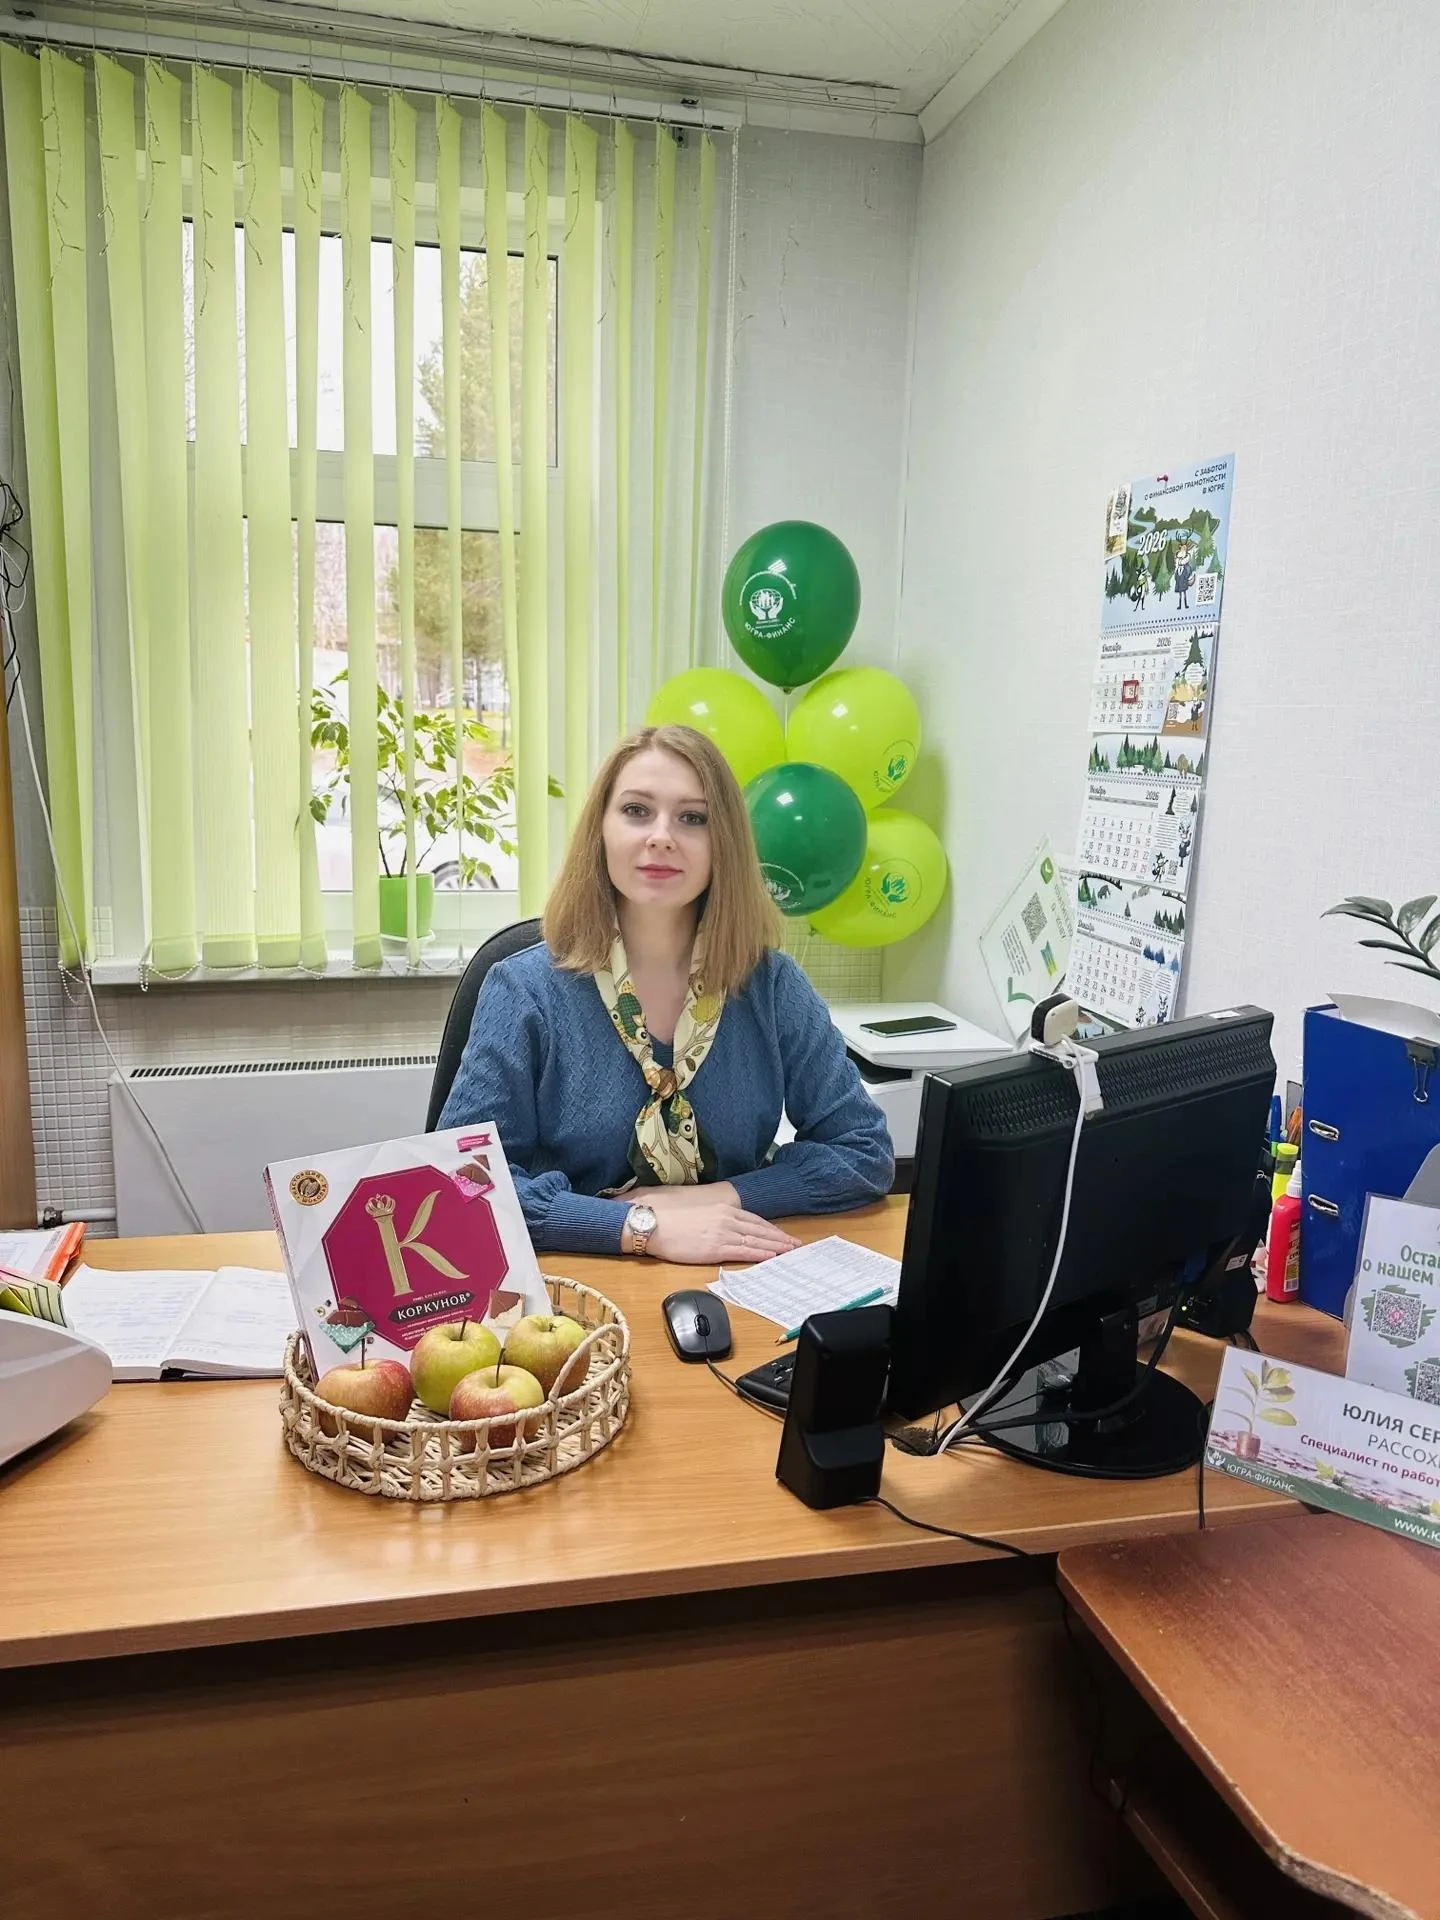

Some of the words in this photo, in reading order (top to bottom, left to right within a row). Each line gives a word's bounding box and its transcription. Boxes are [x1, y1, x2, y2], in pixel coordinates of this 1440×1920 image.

[1200, 462, 1228, 475] ЗАБОТОЙ
[1149, 484, 1184, 499] ФИНАНСОВОЙ
[1184, 473, 1227, 488] ГРАМОТНОСТИ
[1208, 483, 1226, 493] ЮГРЕ
[1137, 529, 1168, 556] 2026
[744, 617, 796, 639] ЮГРА-ФИНАНС
[1400, 1244, 1440, 1269] Оста
[1362, 1258, 1372, 1272] о
[1377, 1261, 1434, 1286] нашем
[397, 1293, 467, 1320] КОРКУНОВ
[1342, 1402, 1404, 1434] ЮЛИЯ
[1300, 1434, 1378, 1468] Специалист
[1382, 1461, 1398, 1474] по
[1367, 1434, 1440, 1469] РАССОХ
[1226, 1462, 1296, 1494] ЮГРА-ФИНАНС
